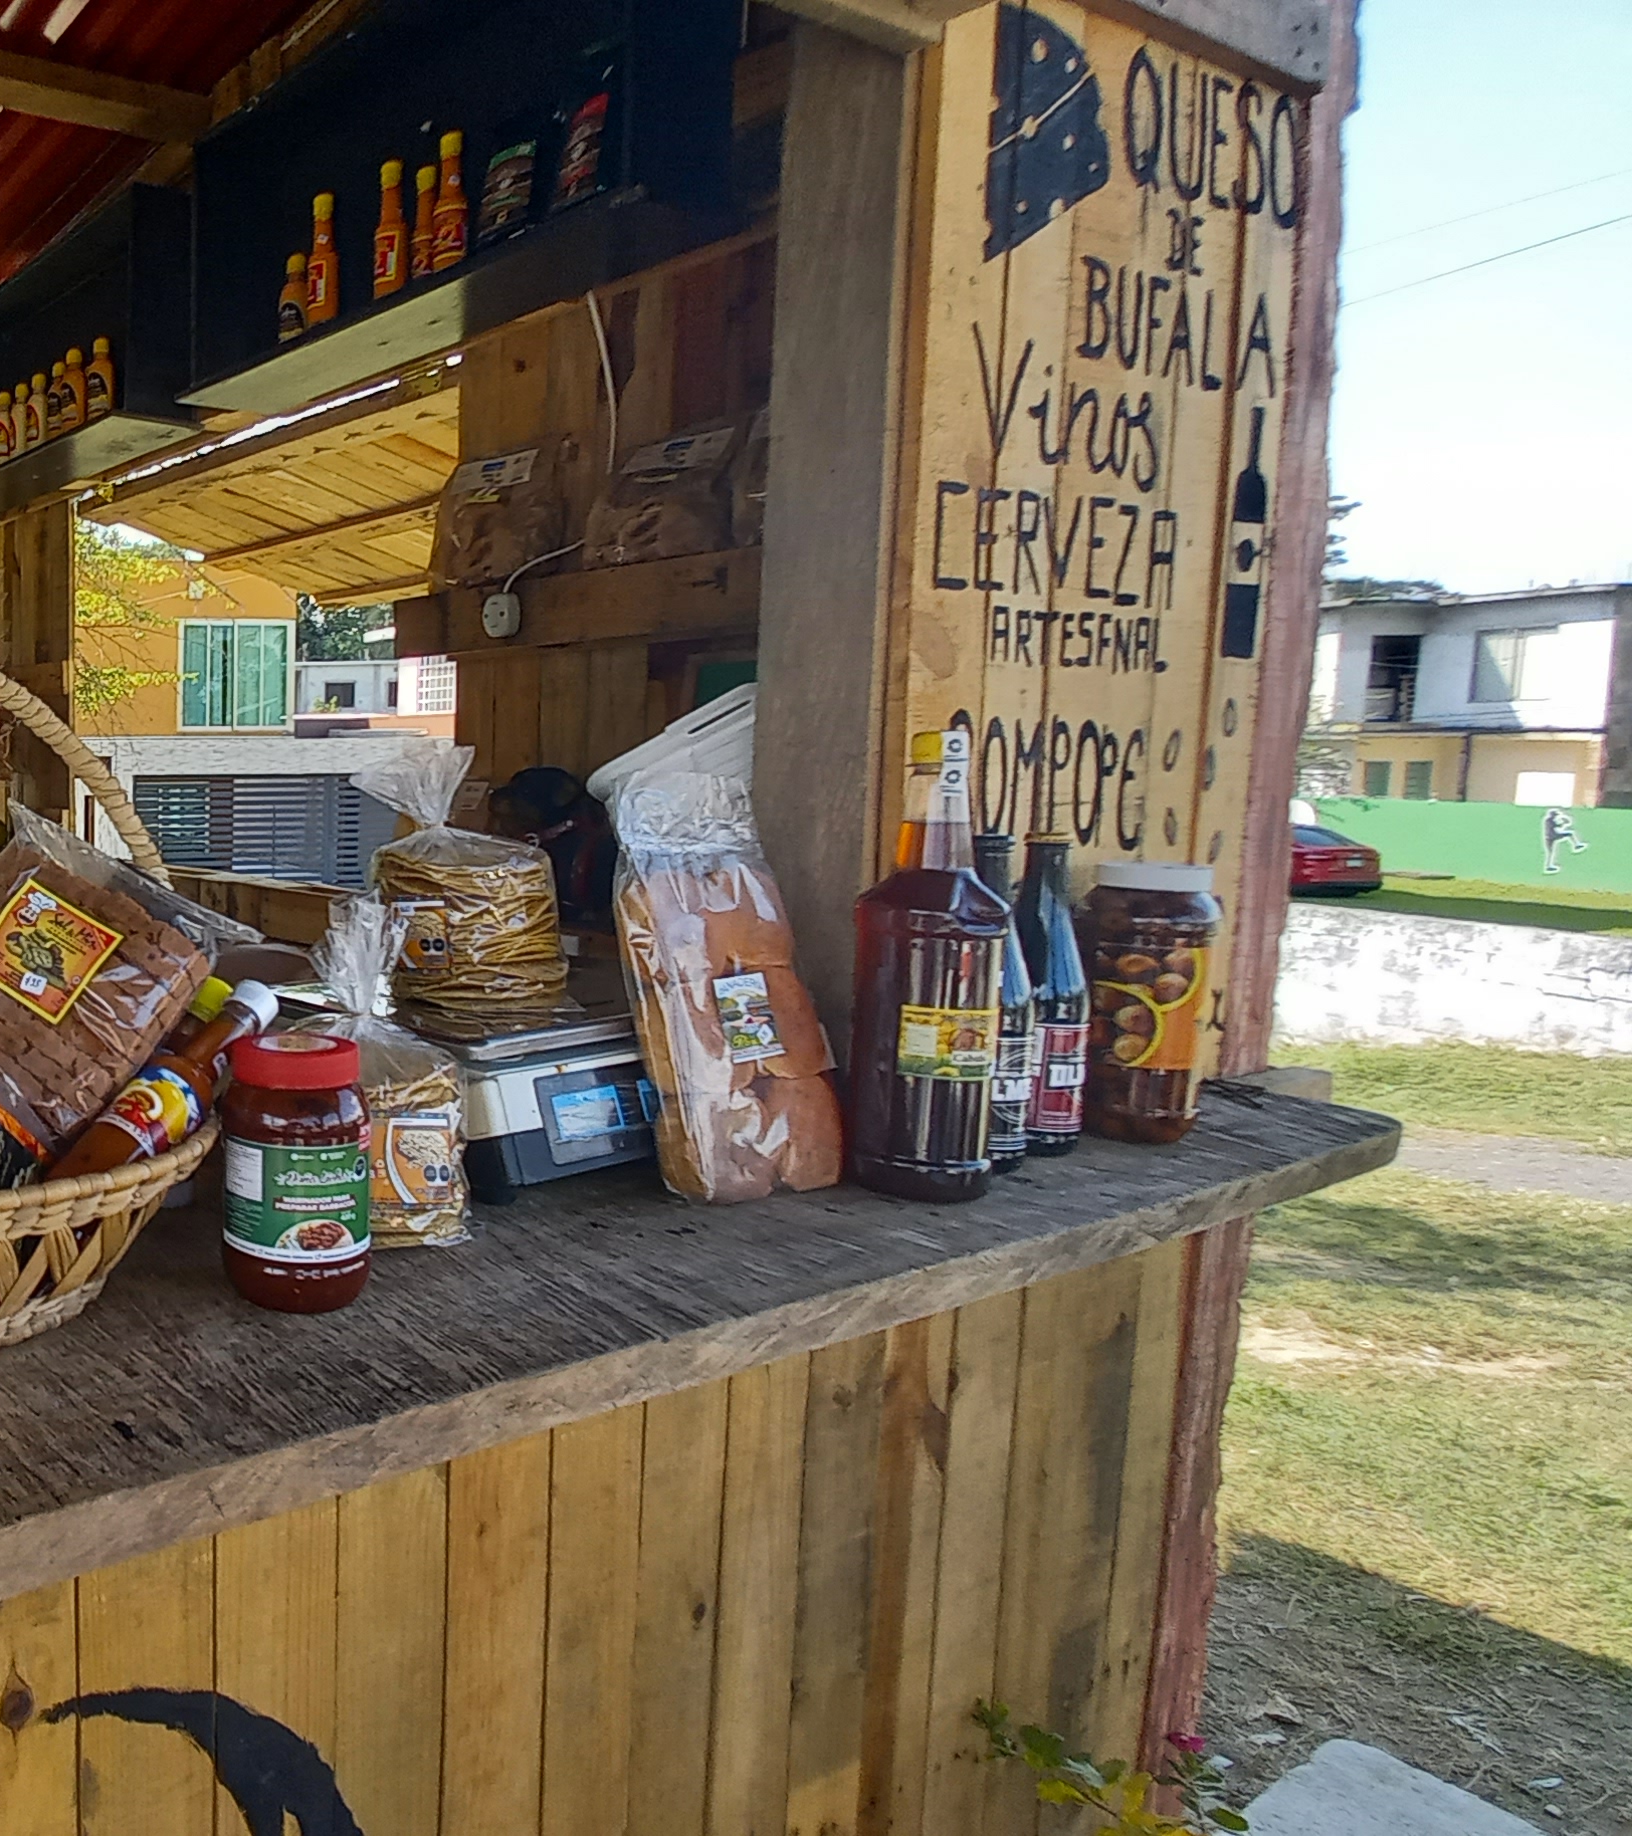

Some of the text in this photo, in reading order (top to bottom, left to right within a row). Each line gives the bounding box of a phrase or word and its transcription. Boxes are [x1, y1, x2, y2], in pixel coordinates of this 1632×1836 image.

[1124, 44, 1299, 230] QUESO
[1166, 208, 1205, 277] DE
[1077, 254, 1276, 399] BUFALA
[972, 320, 1159, 493] Vinos
[932, 480, 1178, 611] CERVEZA
[949, 708, 1146, 852] OMPOPE
